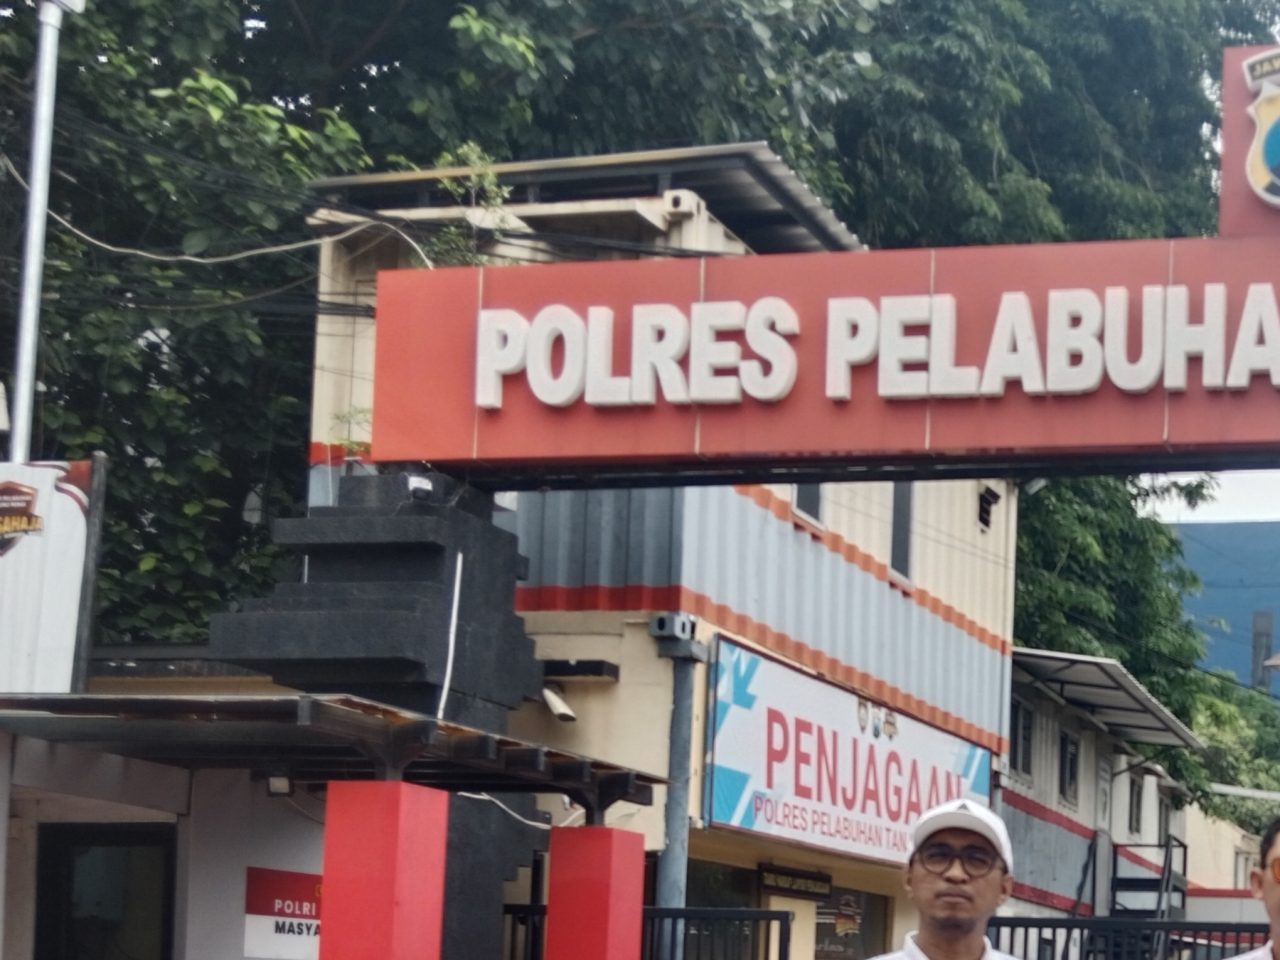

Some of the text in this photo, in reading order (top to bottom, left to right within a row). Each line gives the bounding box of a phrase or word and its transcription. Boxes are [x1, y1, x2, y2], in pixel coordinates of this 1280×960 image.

[476, 297, 800, 409] POLRES
[753, 795, 808, 832] POLRES
[811, 810, 882, 847] PELABUHAN
[274, 899, 316, 916] POLRI
